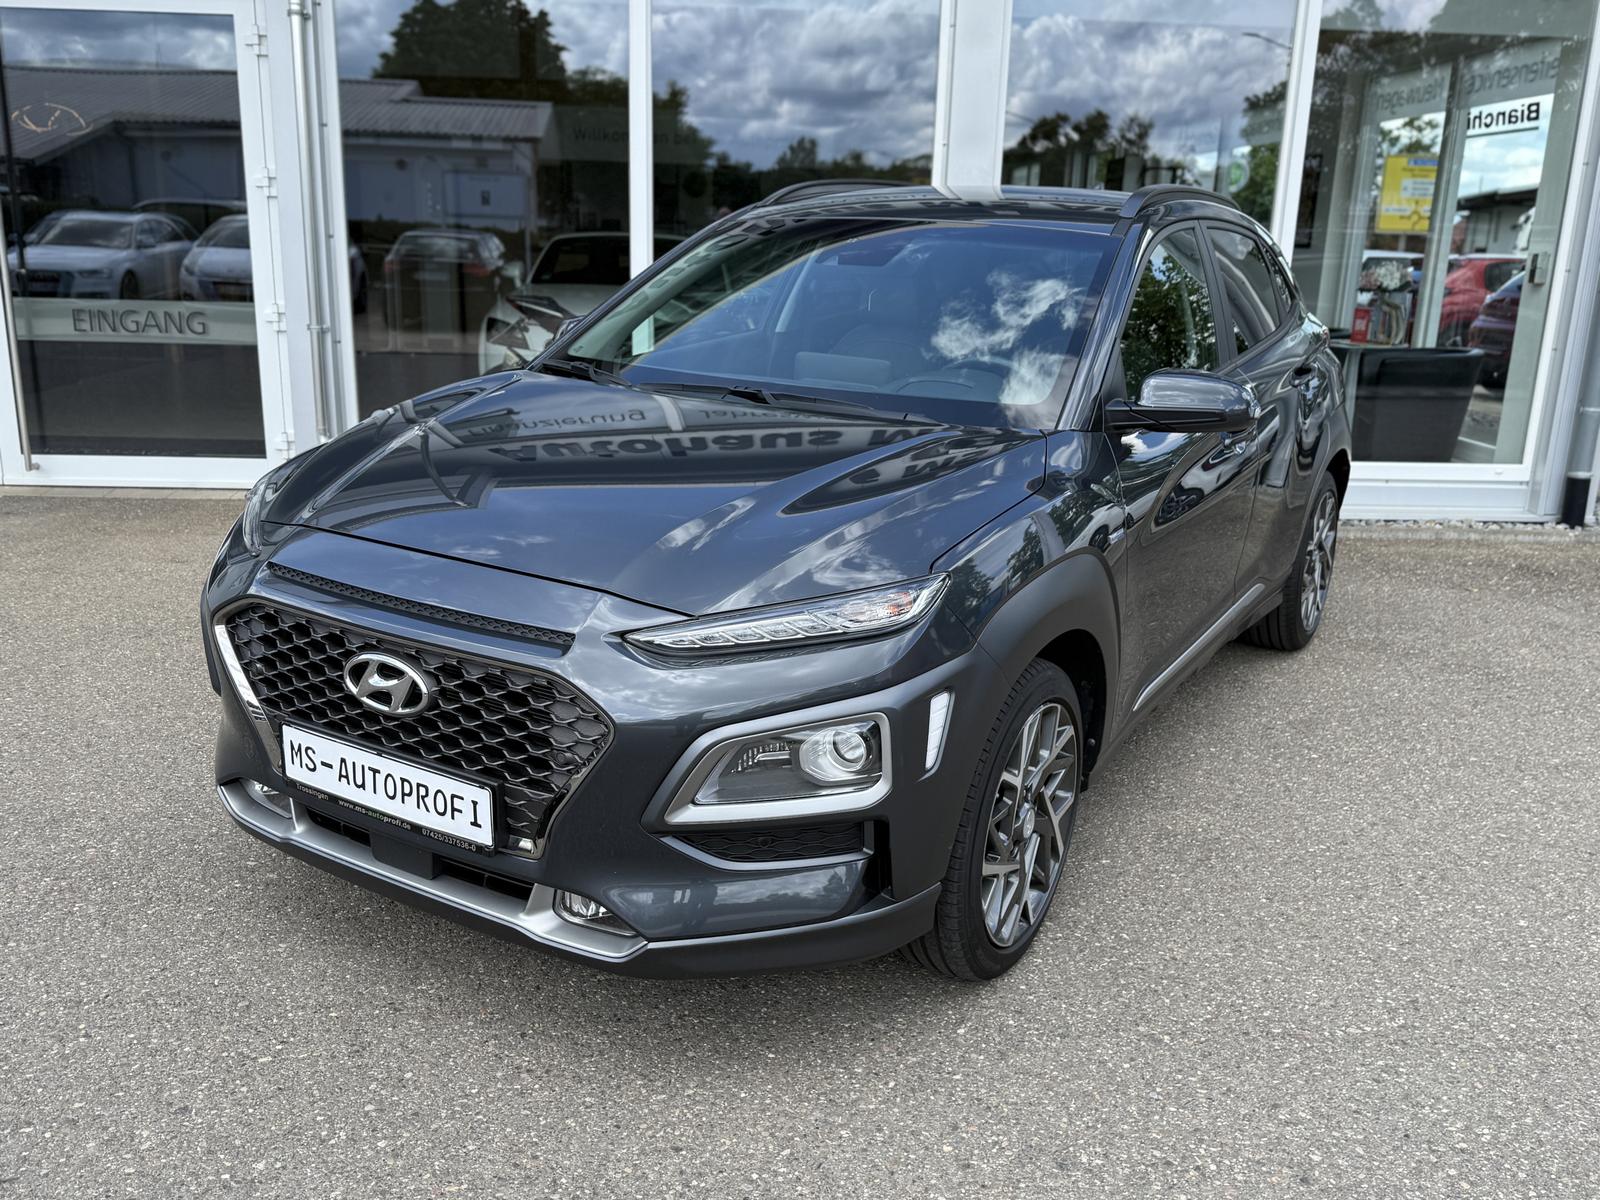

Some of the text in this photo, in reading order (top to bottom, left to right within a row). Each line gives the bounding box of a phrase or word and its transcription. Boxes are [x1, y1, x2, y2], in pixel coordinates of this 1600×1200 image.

[71, 308, 208, 336] EINGANG
[289, 739, 482, 830] MS-AUTOPROFI
[296, 783, 477, 852] Trossingen www.ms-autoprofi.de 07425/337536-0
